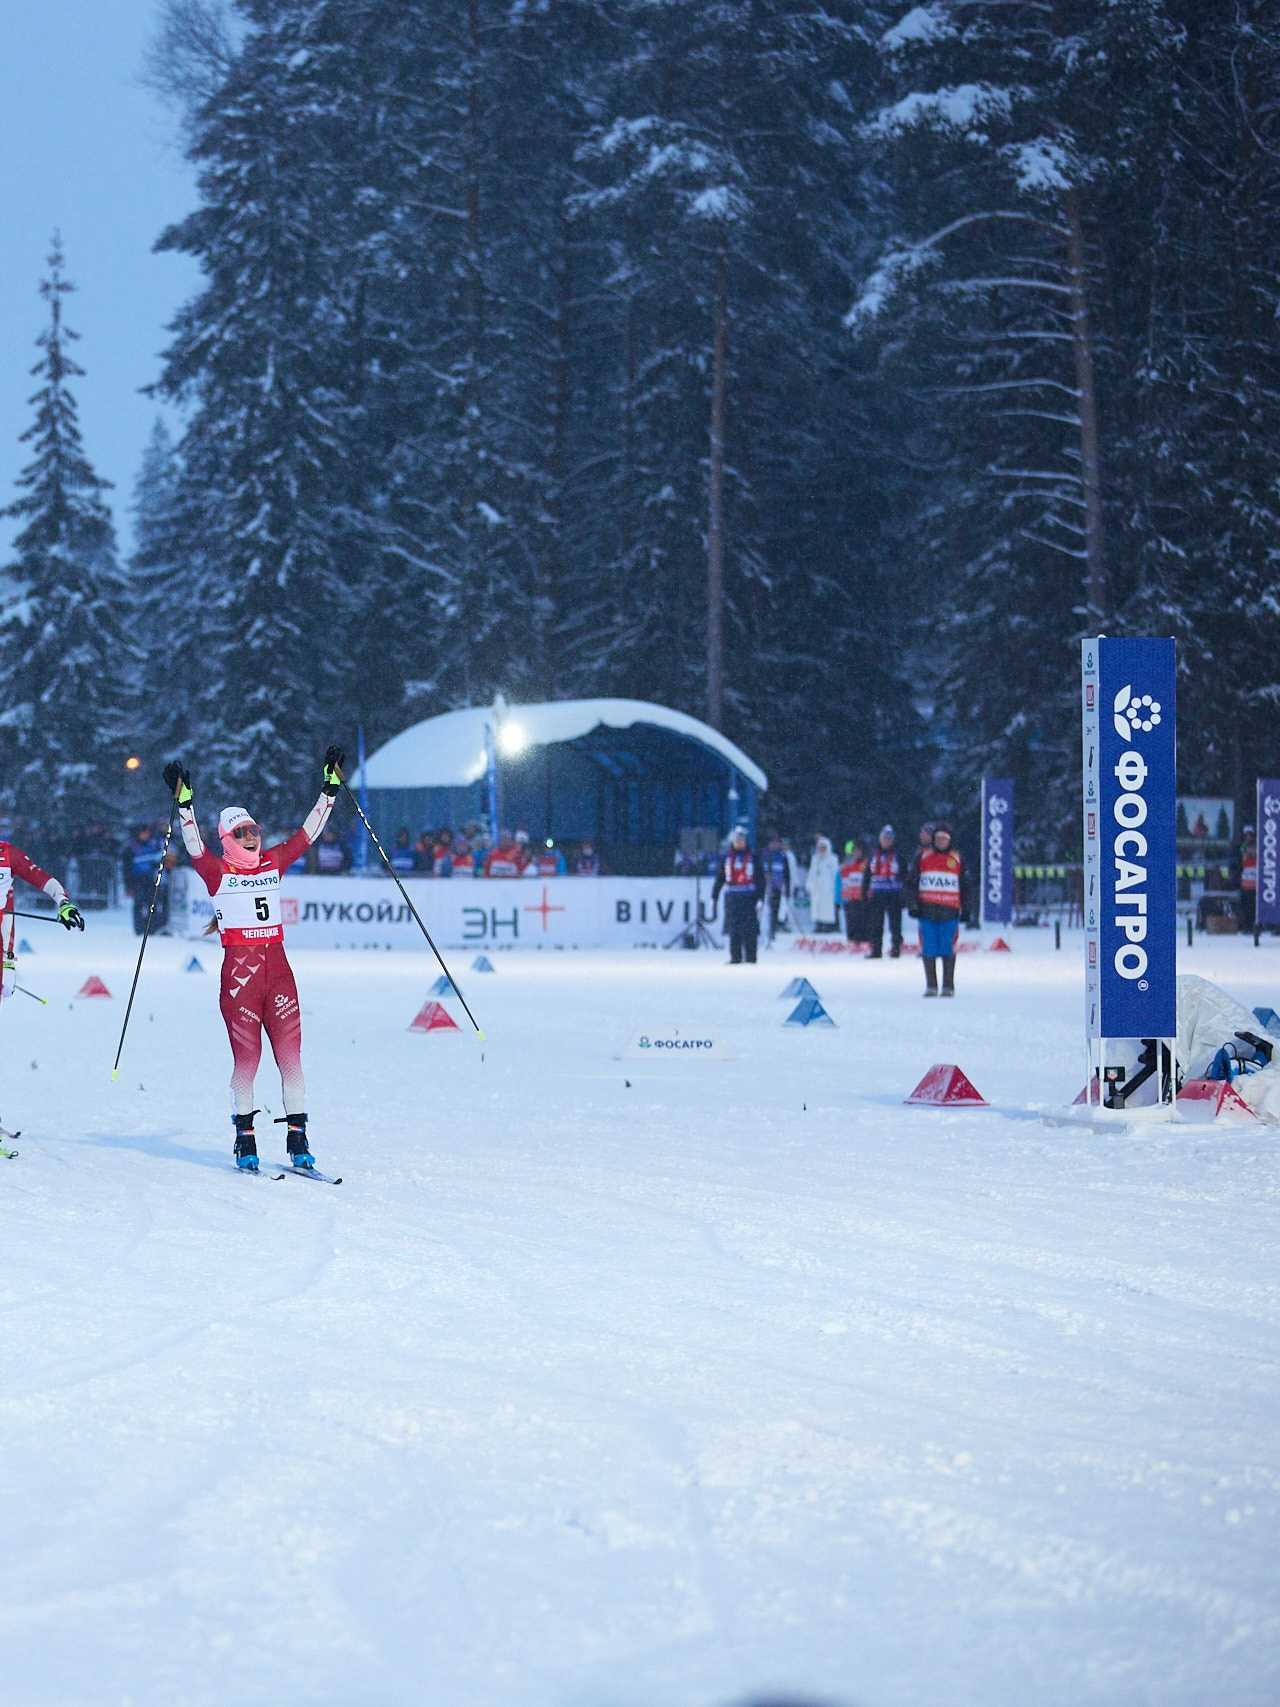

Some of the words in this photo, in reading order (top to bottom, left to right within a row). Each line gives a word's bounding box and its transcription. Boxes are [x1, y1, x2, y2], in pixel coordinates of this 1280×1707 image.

[240, 876, 278, 887] ФОСАГРО
[254, 897, 270, 921] 5
[302, 898, 414, 923] ЛУКОЙЛ
[616, 900, 718, 923] BIVIU
[242, 926, 279, 939] ЧЕПЕЦКОЕ
[653, 1039, 714, 1049] ФОСАГРО
